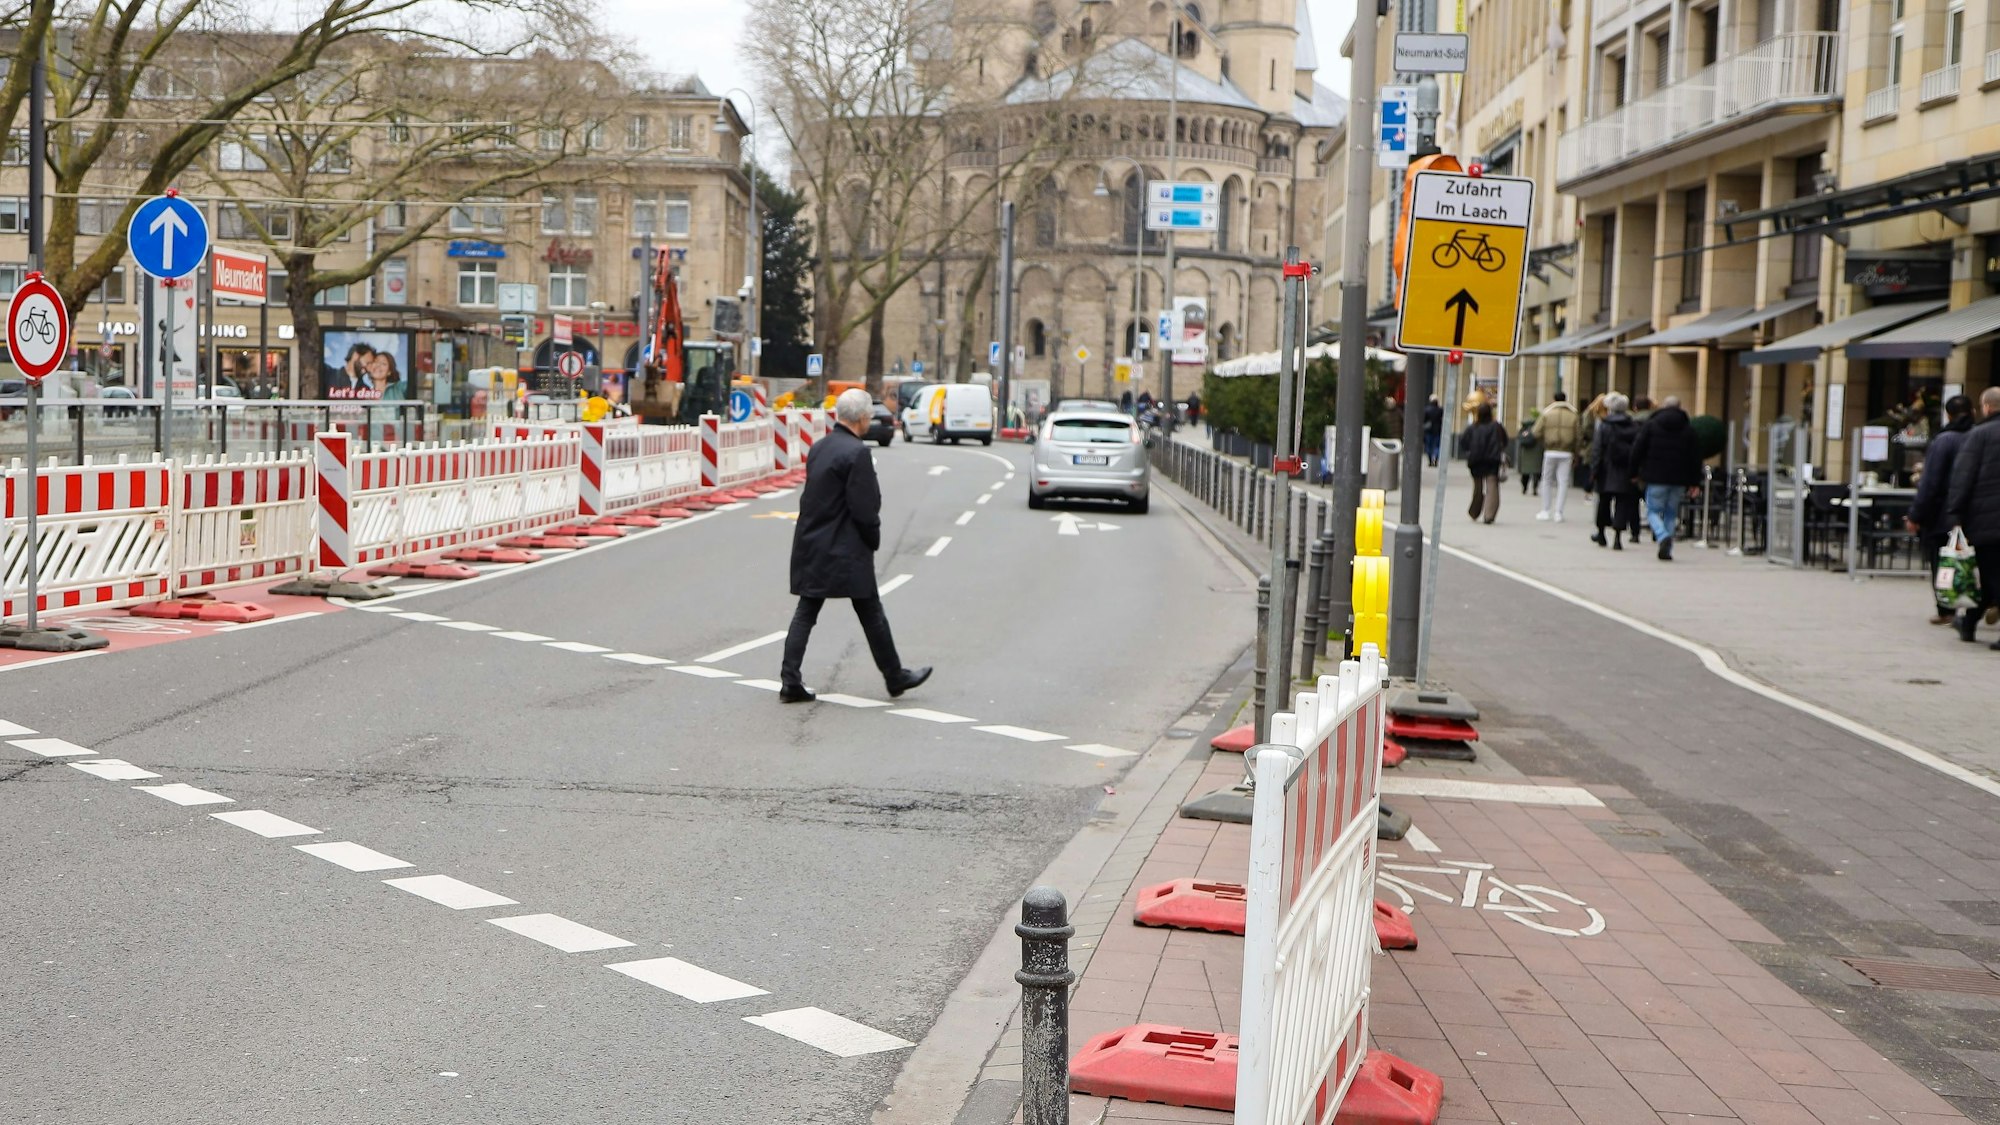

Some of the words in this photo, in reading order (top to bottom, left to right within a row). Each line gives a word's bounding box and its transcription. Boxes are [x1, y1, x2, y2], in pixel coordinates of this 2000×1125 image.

[1397, 47, 1465, 60] Neumarkt-Süd
[1445, 180, 1502, 198] Zufahrt
[1435, 200, 1455, 216] Im
[1462, 202, 1507, 220] Laach
[215, 258, 264, 293] Neumarkt
[328, 386, 356, 399] Let's
[356, 387, 382, 399] date
